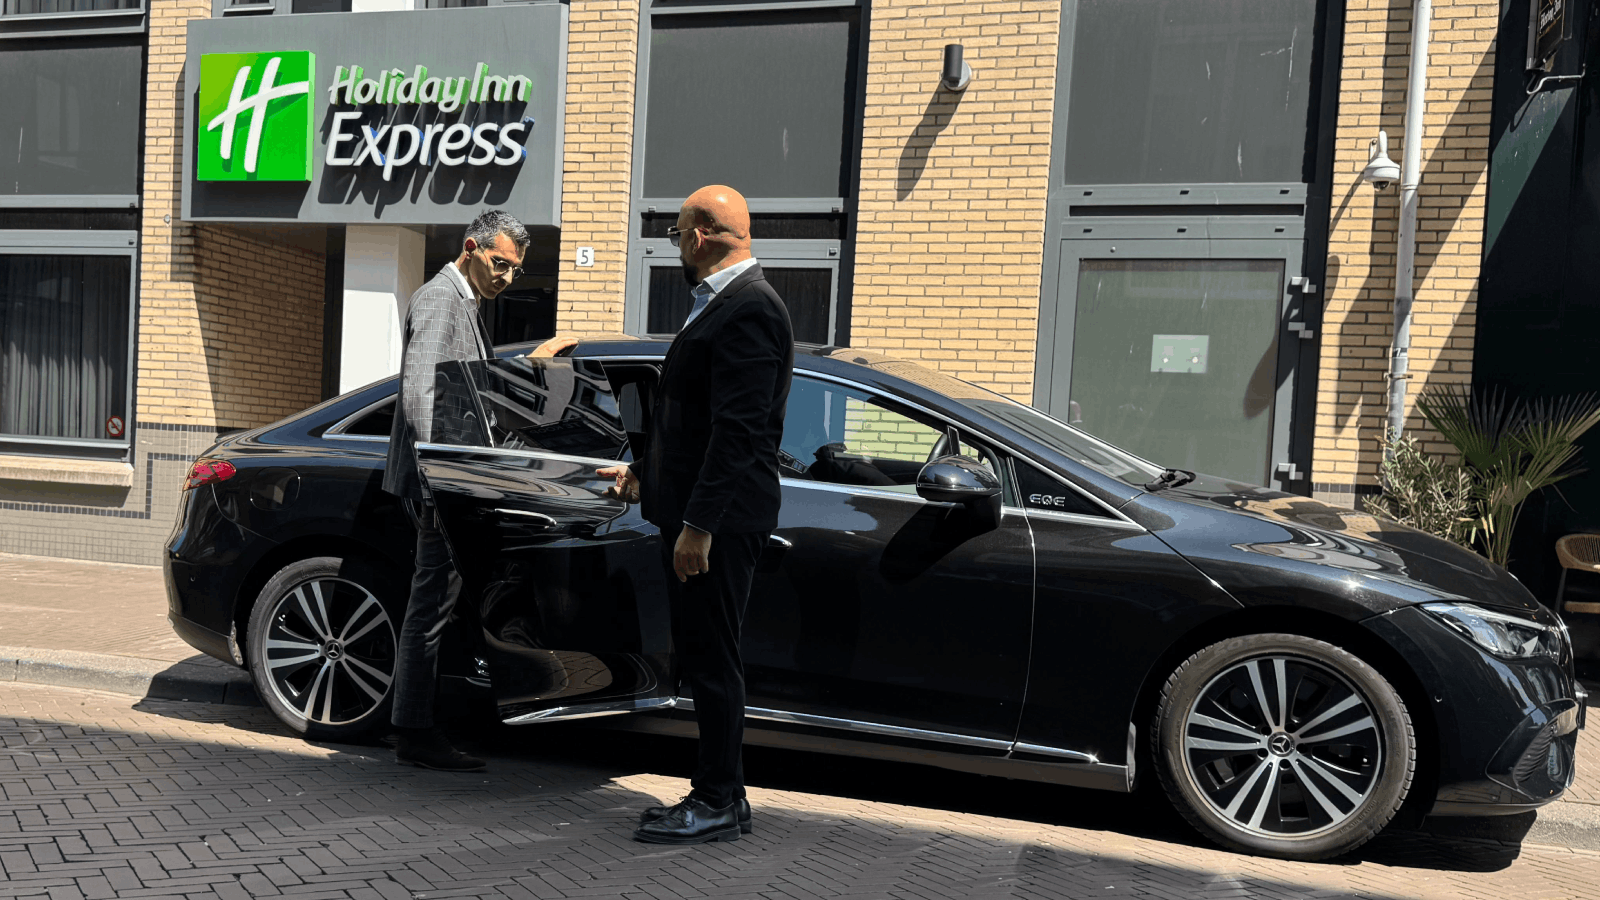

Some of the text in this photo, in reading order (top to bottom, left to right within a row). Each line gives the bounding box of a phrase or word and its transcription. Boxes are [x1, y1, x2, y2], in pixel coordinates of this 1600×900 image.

[328, 62, 532, 113] Holiday Inn
[325, 111, 529, 182] Express
[580, 249, 589, 265] 5
[1029, 493, 1066, 507] EQE
